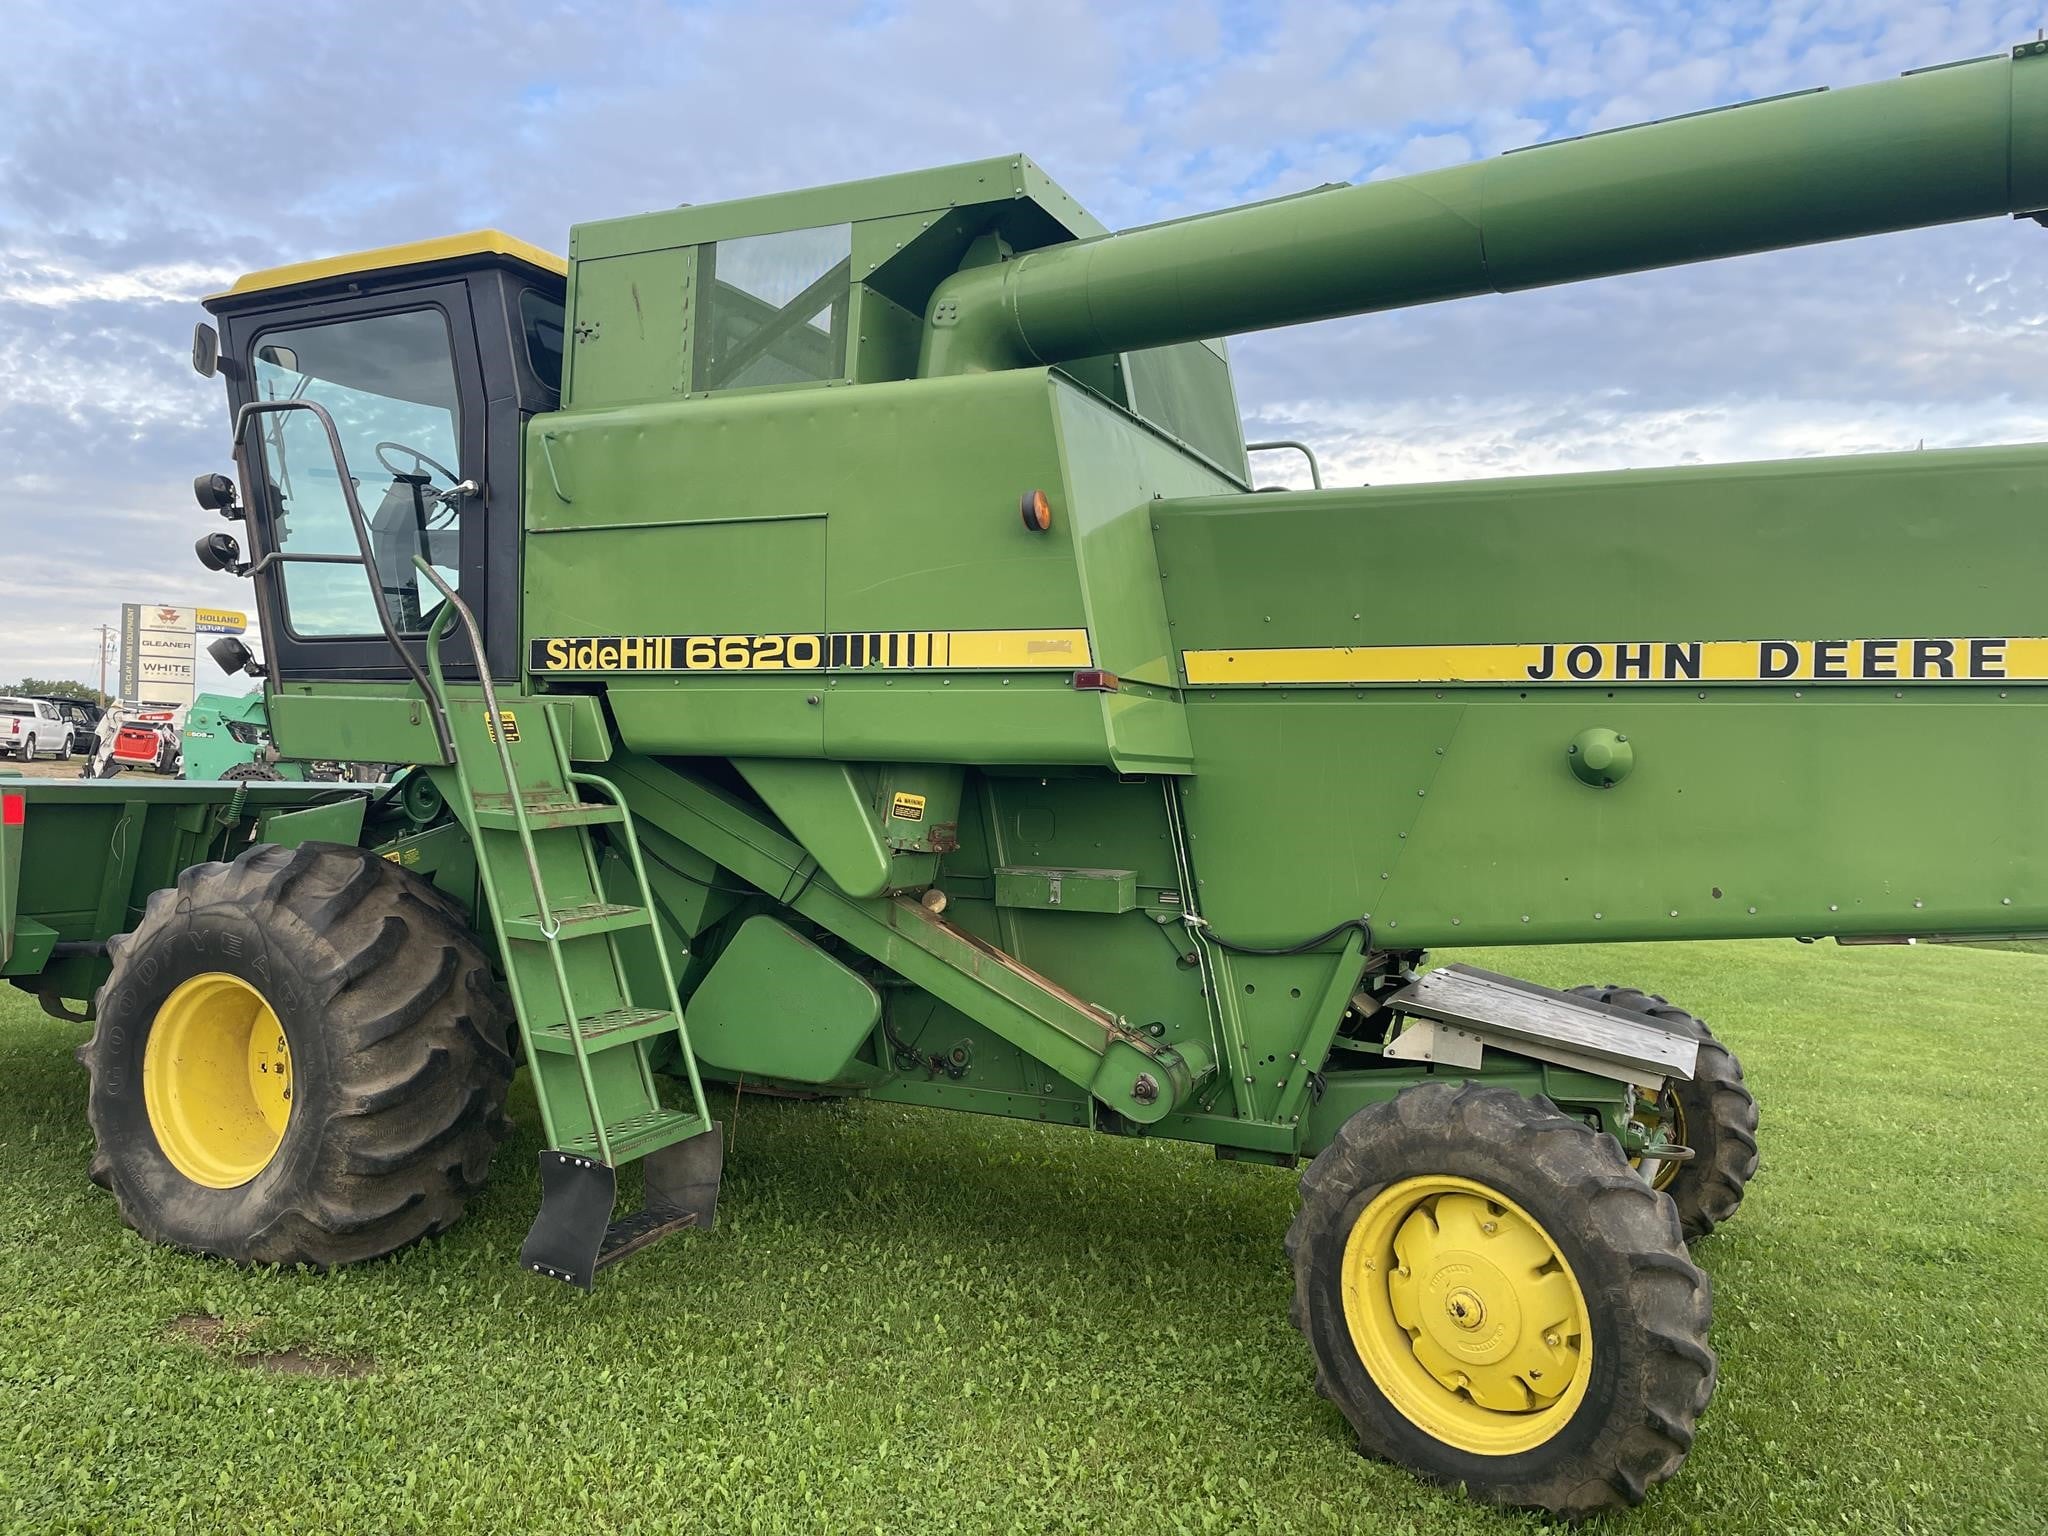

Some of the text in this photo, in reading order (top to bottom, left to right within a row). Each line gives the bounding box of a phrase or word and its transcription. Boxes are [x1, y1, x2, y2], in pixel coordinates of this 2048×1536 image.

[199, 615, 240, 624] HOLLAND
[142, 640, 191, 648] GLEANER
[545, 635, 821, 670] SideHill 6620
[1527, 639, 2008, 680] JOHN DEERE
[143, 663, 191, 673] WHITE
